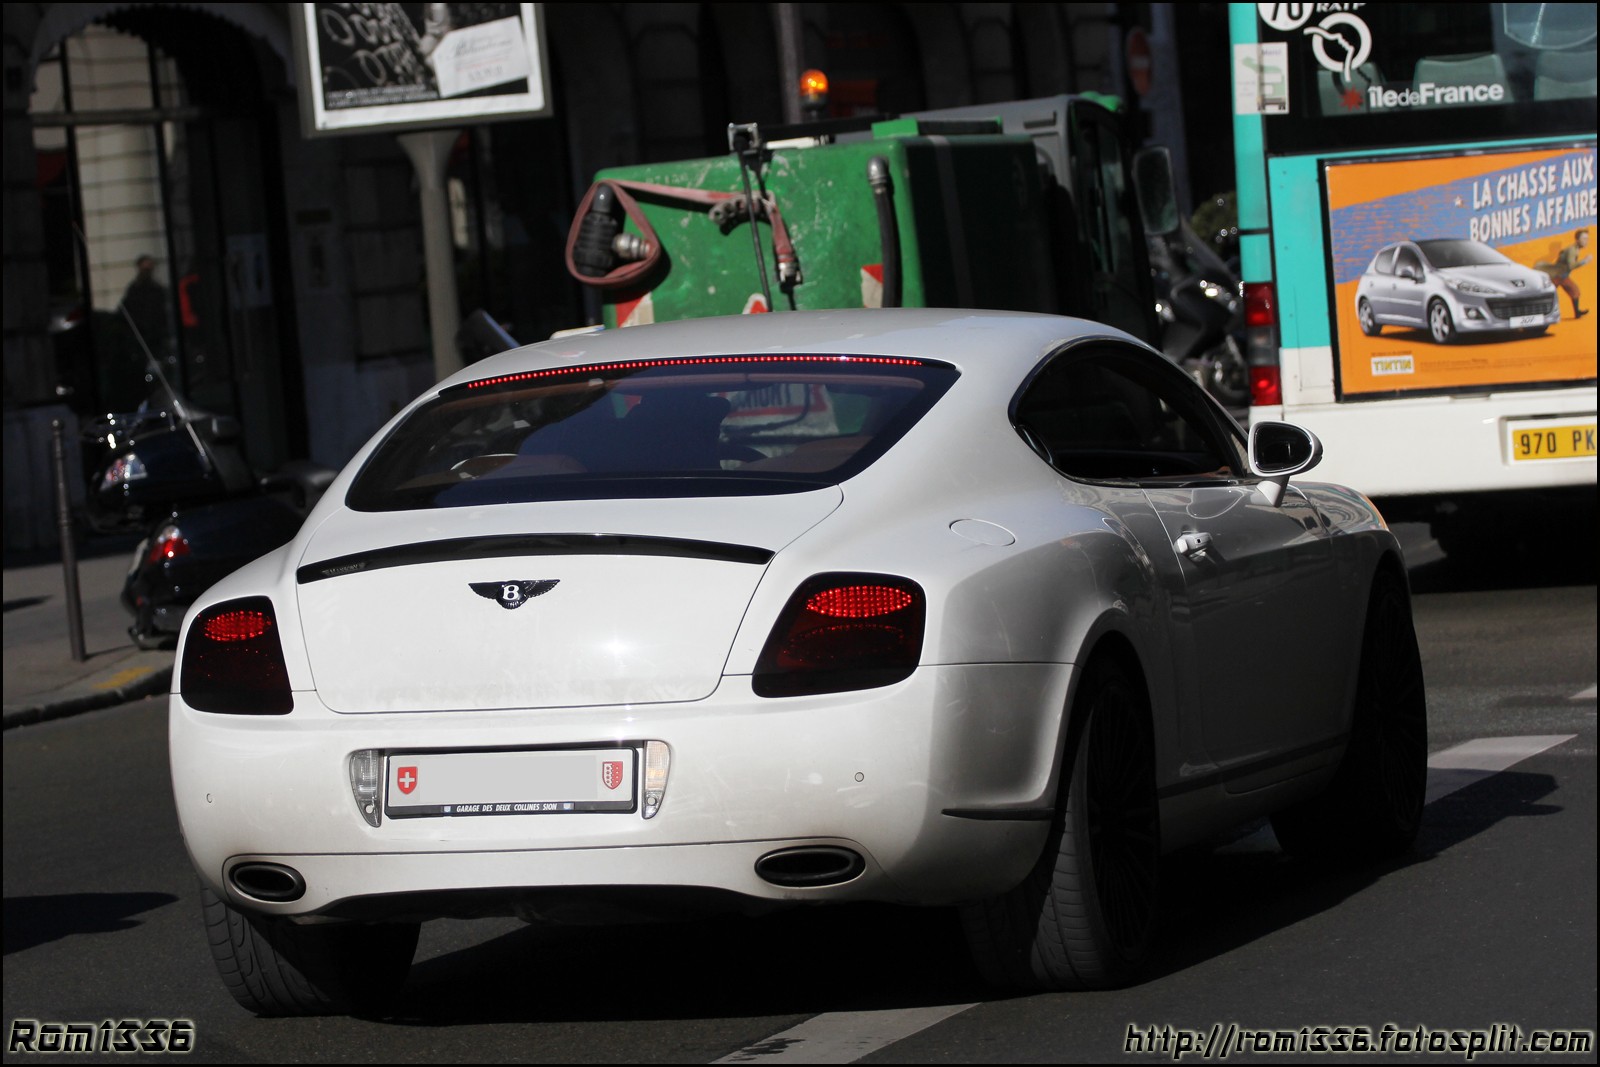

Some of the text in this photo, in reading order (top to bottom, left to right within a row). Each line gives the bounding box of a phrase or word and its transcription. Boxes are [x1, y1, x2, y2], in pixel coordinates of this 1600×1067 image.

[1472, 154, 1595, 210] LA CHASSE AUX
[1469, 203, 1531, 242] BONNES
[1373, 359, 1412, 371] TINTIN
[1520, 429, 1596, 455] 970 PK
[502, 584, 520, 601] B
[456, 802, 558, 813] GARAGE DES DEUX COLLINES SION
